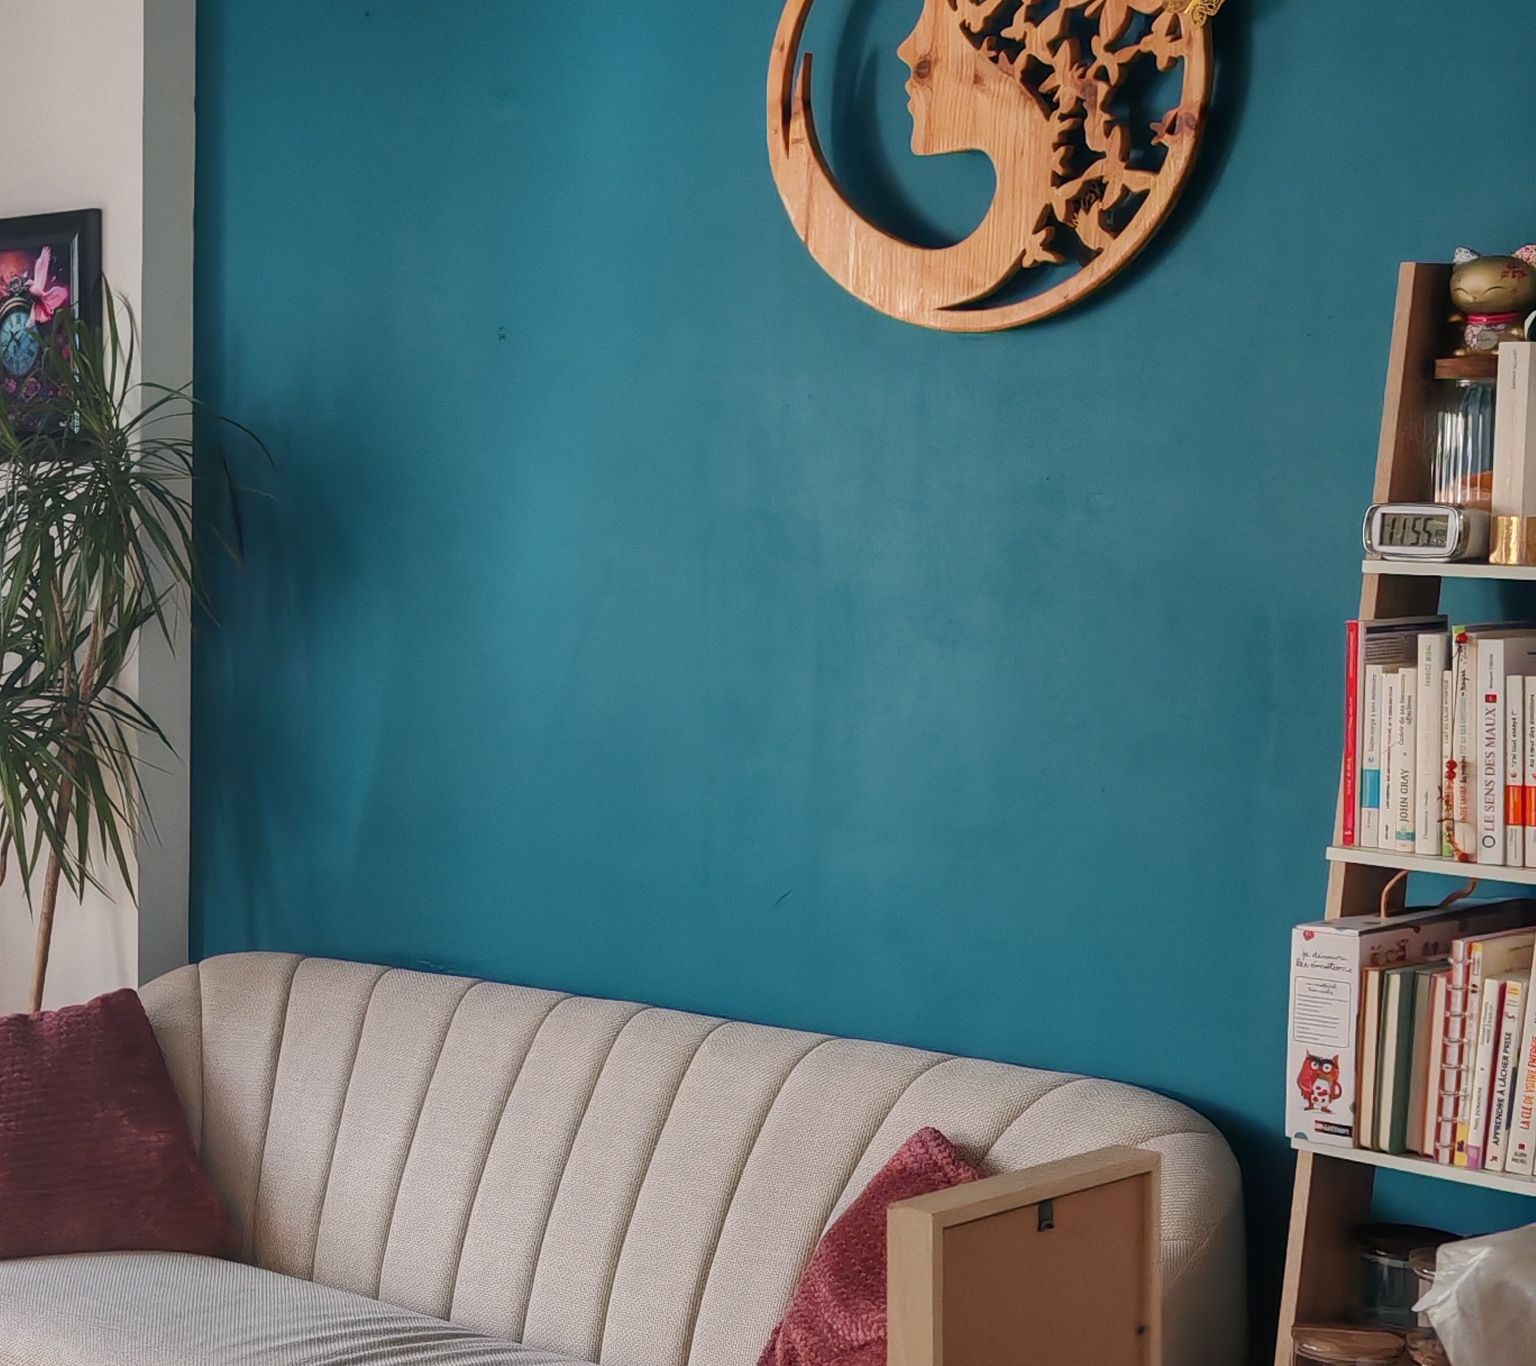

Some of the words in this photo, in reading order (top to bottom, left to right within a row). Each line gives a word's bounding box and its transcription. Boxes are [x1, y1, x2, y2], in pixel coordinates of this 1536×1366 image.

[1484, 707, 1497, 748] MAUX
[1483, 751, 1496, 776] DES
[1400, 768, 1410, 794] GRAY
[1483, 779, 1496, 813] SENS
[1399, 797, 1410, 823] JOHN
[1483, 815, 1495, 832] LE
[1492, 1097, 1505, 1146] APPRENDRE
[1518, 1120, 1531, 1130] LA
